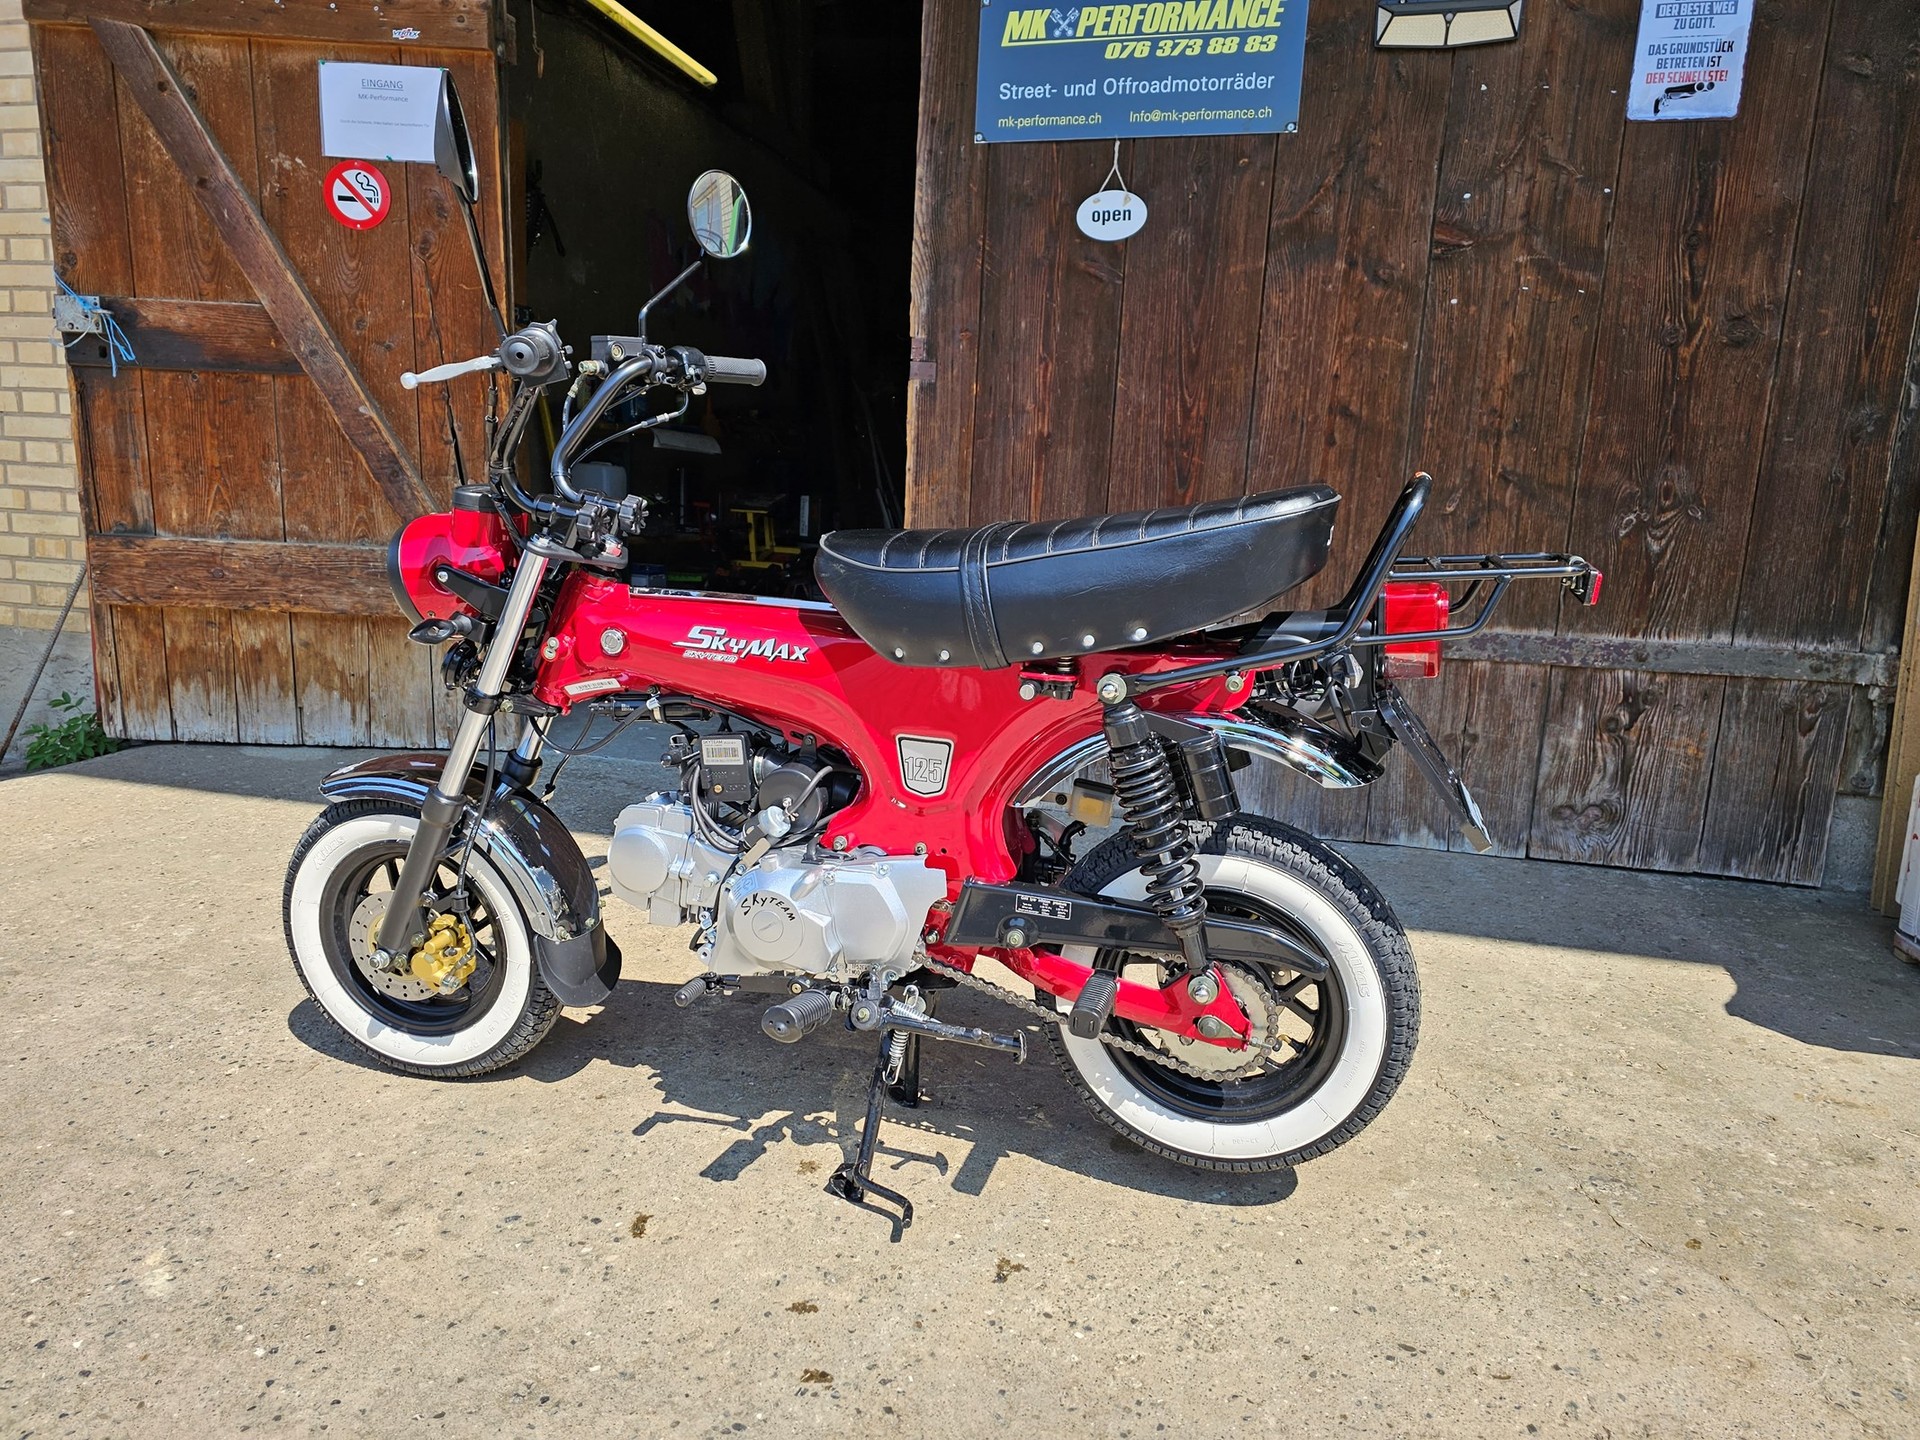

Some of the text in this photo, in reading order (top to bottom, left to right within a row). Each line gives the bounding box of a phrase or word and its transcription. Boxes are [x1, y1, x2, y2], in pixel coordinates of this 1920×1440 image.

[1659, 1, 1735, 17] DER BESTE WEG
[1002, 0, 1286, 44] MK PERFORMANCE
[1674, 17, 1715, 30] ZU GOTT.
[1105, 34, 1278, 59] 076 373 88 83
[1648, 39, 1735, 56] DAS GRUNDSTÜCK
[1656, 55, 1722, 70] BETRETEN IST
[361, 78, 404, 90] EINGANG
[1646, 69, 1728, 85] DER SCHNELLSTE!
[999, 72, 1275, 100] Street- und Offroadmotorräder
[358, 93, 409, 103] MK-Performance
[998, 112, 1102, 129] mk-performance.ch
[1130, 106, 1273, 123] Info@mk-performance.ch
[1091, 207, 1132, 226] open
[904, 756, 943, 784] 125
[740, 892, 796, 922] SKYTEAM
